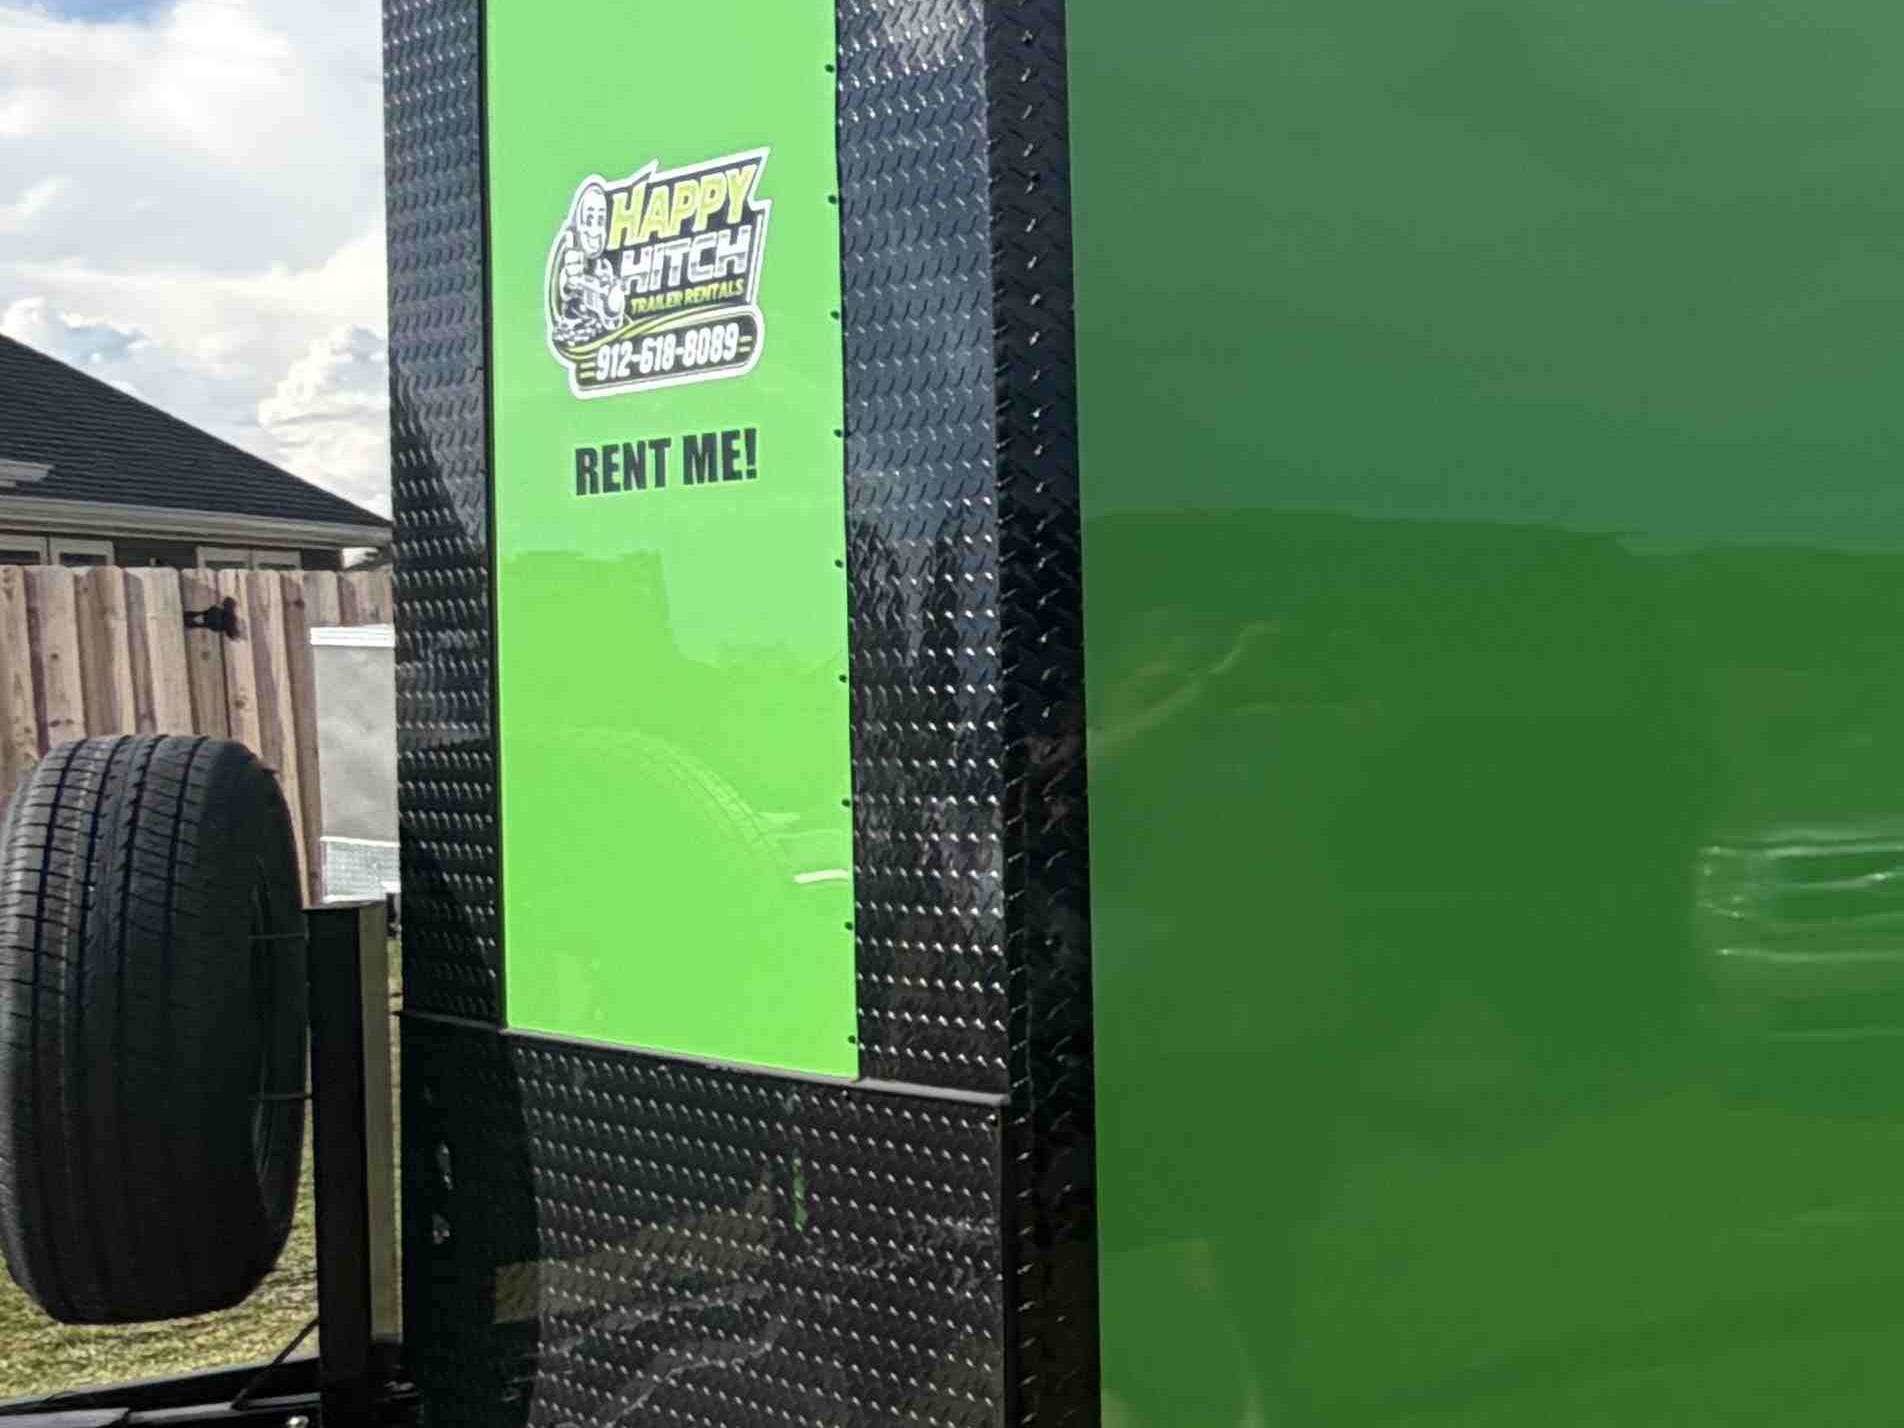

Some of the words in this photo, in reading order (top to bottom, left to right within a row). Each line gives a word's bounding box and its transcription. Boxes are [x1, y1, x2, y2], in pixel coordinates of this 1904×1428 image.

[606, 164, 757, 251] HAPPY
[621, 225, 752, 295] HITCH
[596, 323, 738, 381] 912-618-8089
[575, 437, 672, 496] RENT
[682, 428, 757, 486] ME!
